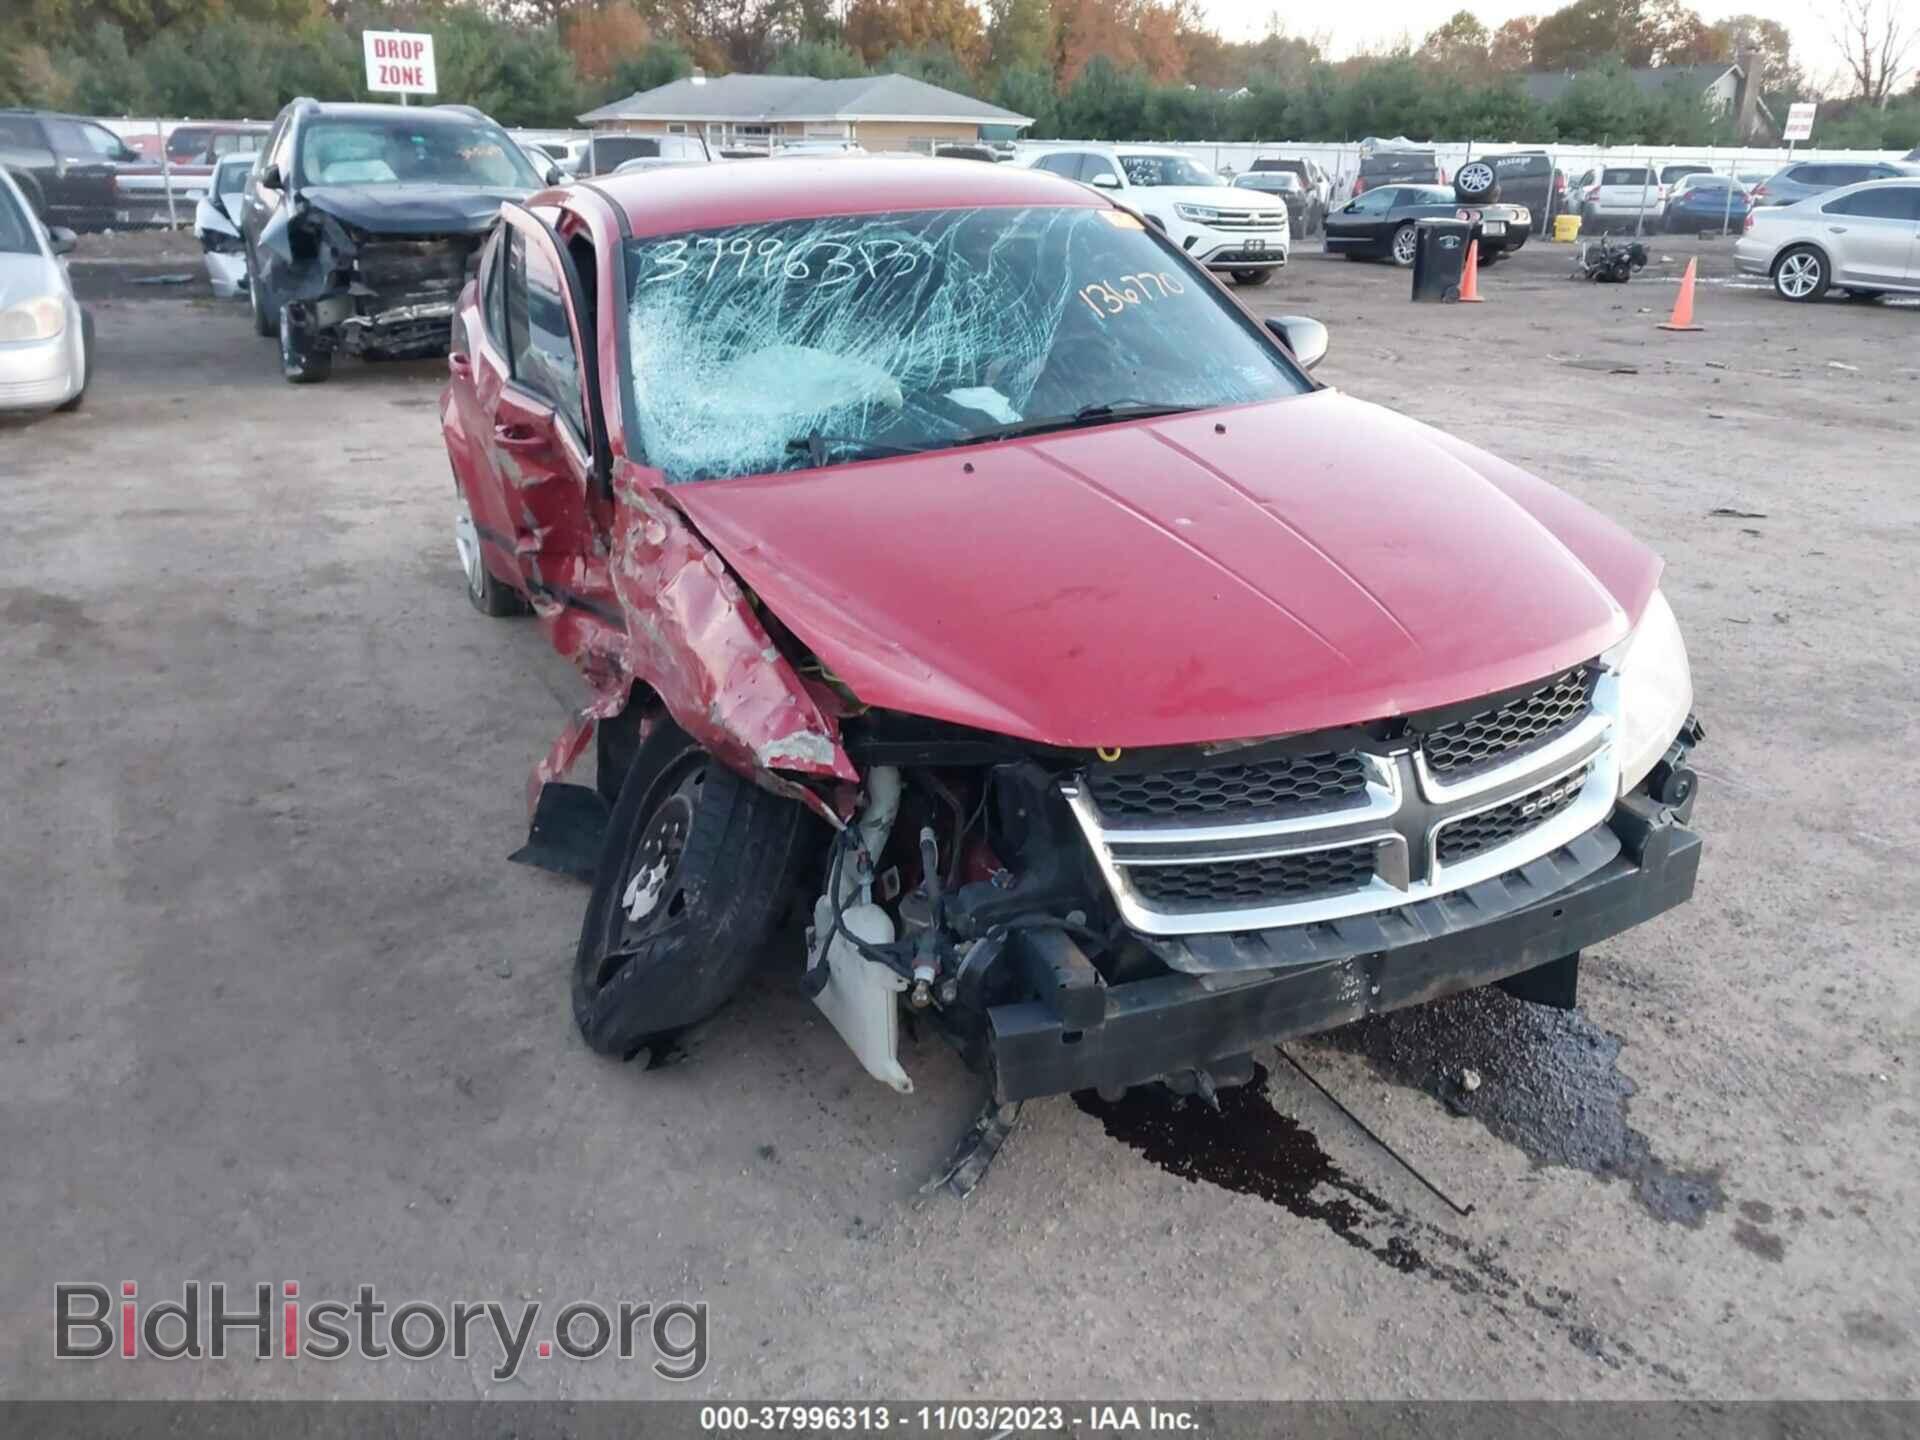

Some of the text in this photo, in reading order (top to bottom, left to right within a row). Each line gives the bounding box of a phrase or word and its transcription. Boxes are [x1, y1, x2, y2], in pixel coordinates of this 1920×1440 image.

[374, 39, 424, 60] DROP
[379, 65, 424, 86] ZONE
[1079, 272, 1184, 319] 136770
